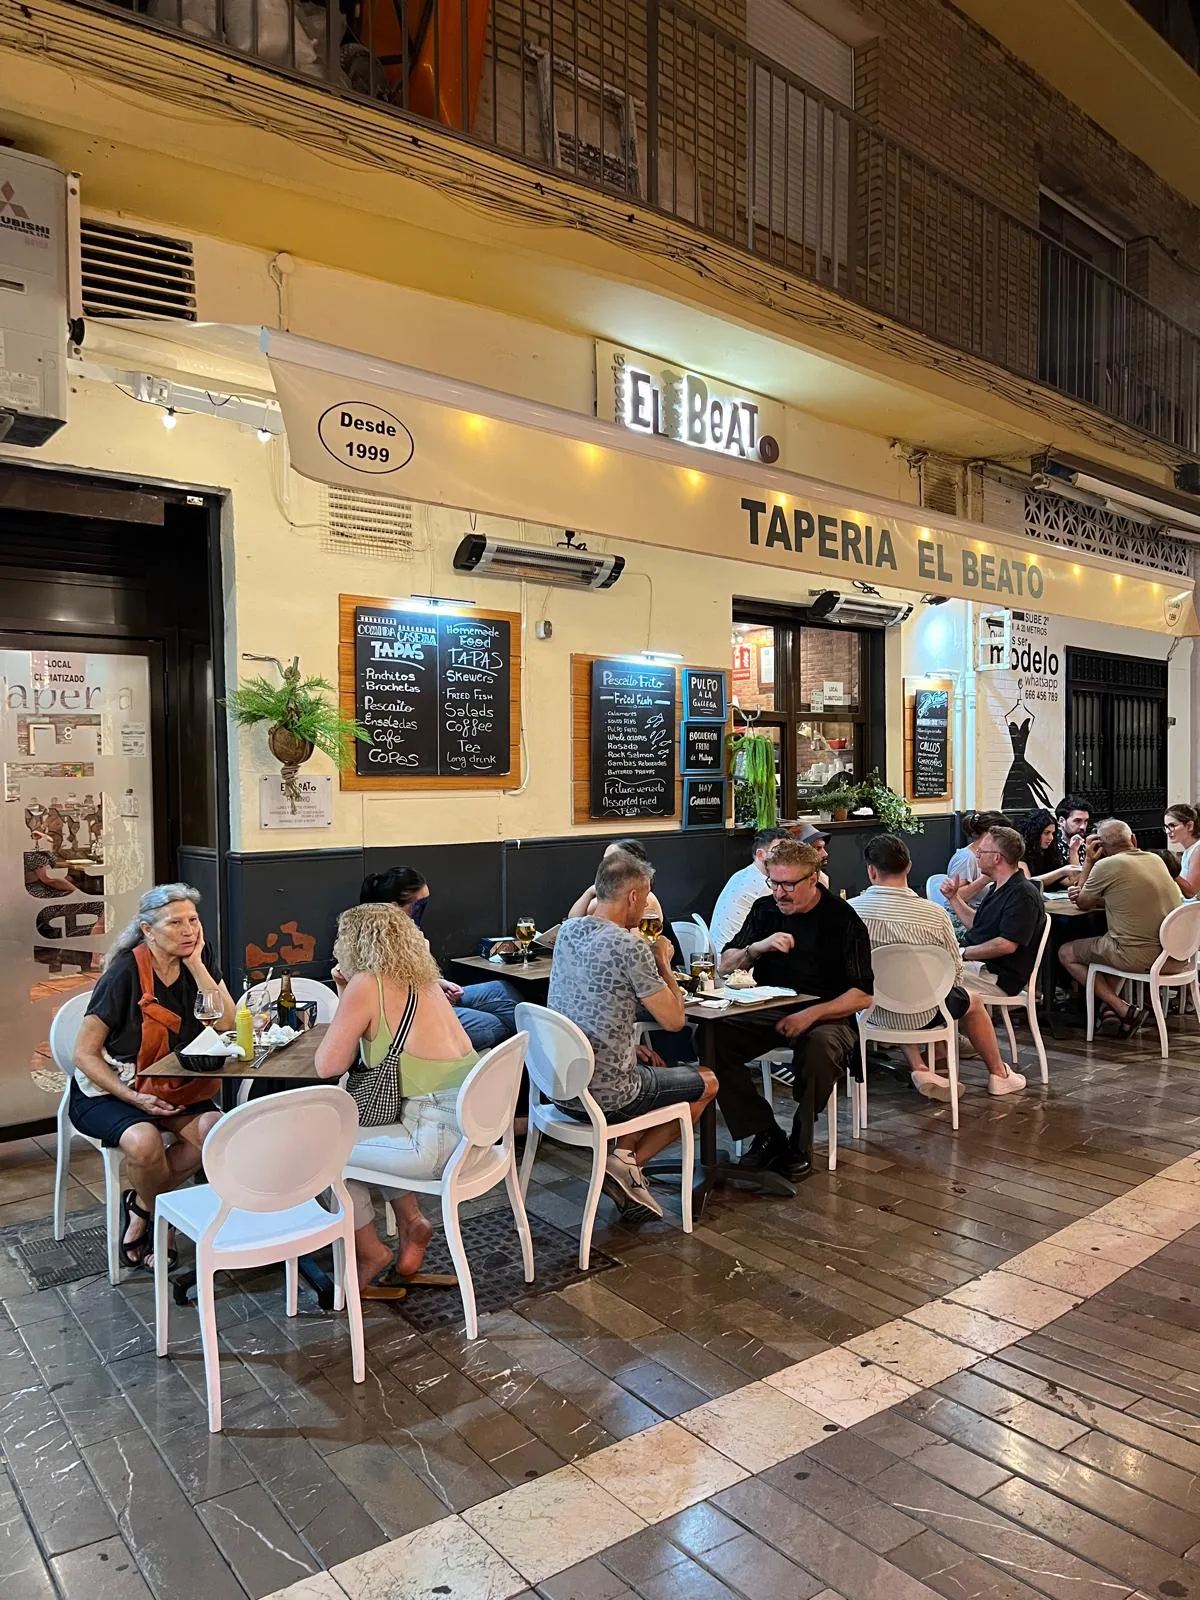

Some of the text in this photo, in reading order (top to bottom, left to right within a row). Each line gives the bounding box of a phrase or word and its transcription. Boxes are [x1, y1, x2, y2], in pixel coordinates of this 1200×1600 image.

[340, 411, 397, 437] Desde
[345, 441, 390, 463] 1999
[741, 497, 1044, 599] TAPERIA EL BEATO
[1025, 612, 1042, 625] SUBE
[357, 624, 397, 637] COMIDA
[446, 624, 500, 638] Homemade
[1026, 626, 1048, 636] METROS
[459, 635, 491, 649] Food
[1017, 637, 1028, 646] ser
[370, 641, 425, 660] TAPAS
[47, 660, 72, 669] LOCAL
[448, 648, 504, 669] TAPAS
[990, 643, 1059, 675] modelo
[34, 673, 85, 683] CLMATIZADO
[690, 676, 718, 693] PULPO
[1025, 673, 1058, 690] whatsapp
[366, 681, 421, 693] Brochetas
[614, 691, 653, 706] Fried Fish
[704, 691, 712, 699] LA
[1025, 690, 1036, 700] 666
[1036, 690, 1047, 701] 456
[445, 703, 494, 718] Salads
[446, 718, 493, 737] Coffee
[457, 739, 481, 754] Tea
[607, 742, 638, 750] Rosada
[607, 759, 637, 767] Gambas
[698, 784, 713, 793] HAY
